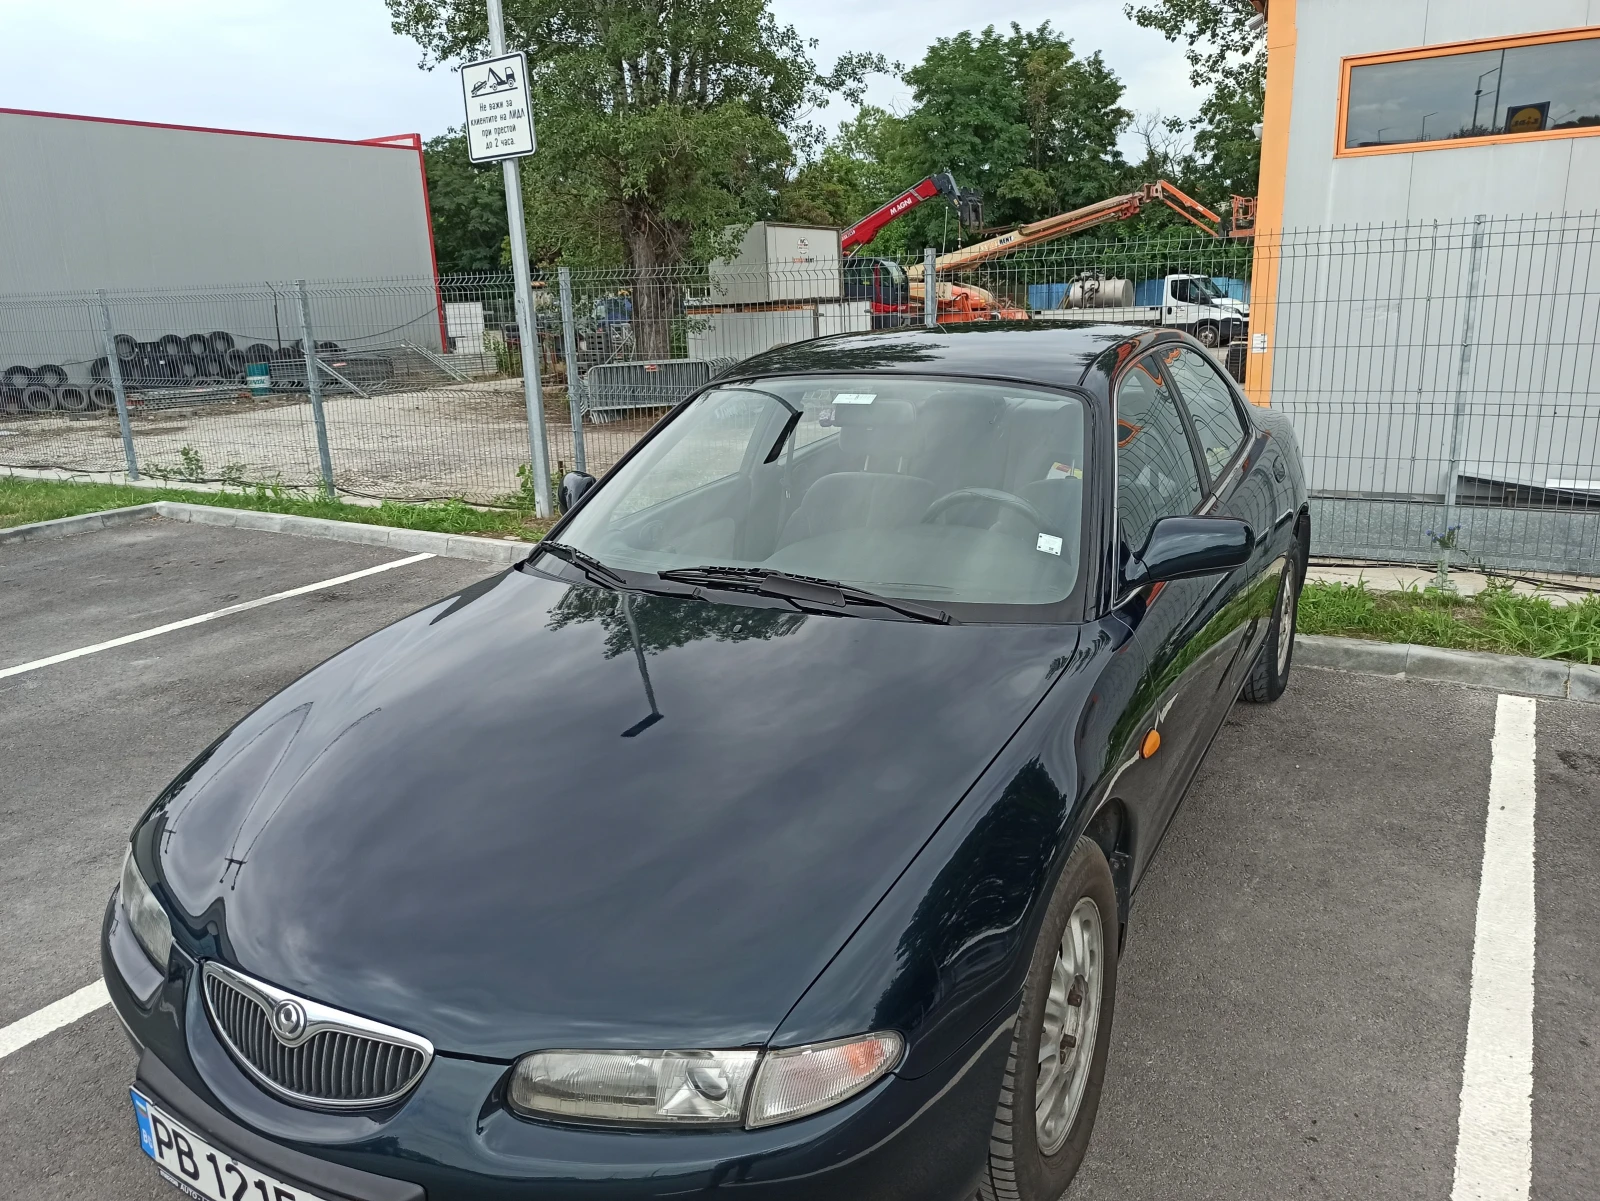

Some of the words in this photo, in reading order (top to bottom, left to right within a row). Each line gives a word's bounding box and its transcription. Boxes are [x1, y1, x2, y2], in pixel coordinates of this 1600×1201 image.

[480, 103, 487, 112] Не
[489, 101, 503, 110] важи
[471, 115, 498, 126] клиентите
[500, 113, 507, 121] на
[509, 108, 525, 119] ЛИДЛ
[482, 129, 492, 138] при
[494, 124, 516, 136] престой
[486, 141, 493, 150] до
[495, 138, 499, 148] 2
[889, 197, 913, 216] MAGNI
[142, 1128, 154, 1149] BG
[151, 1113, 200, 1181] PB
